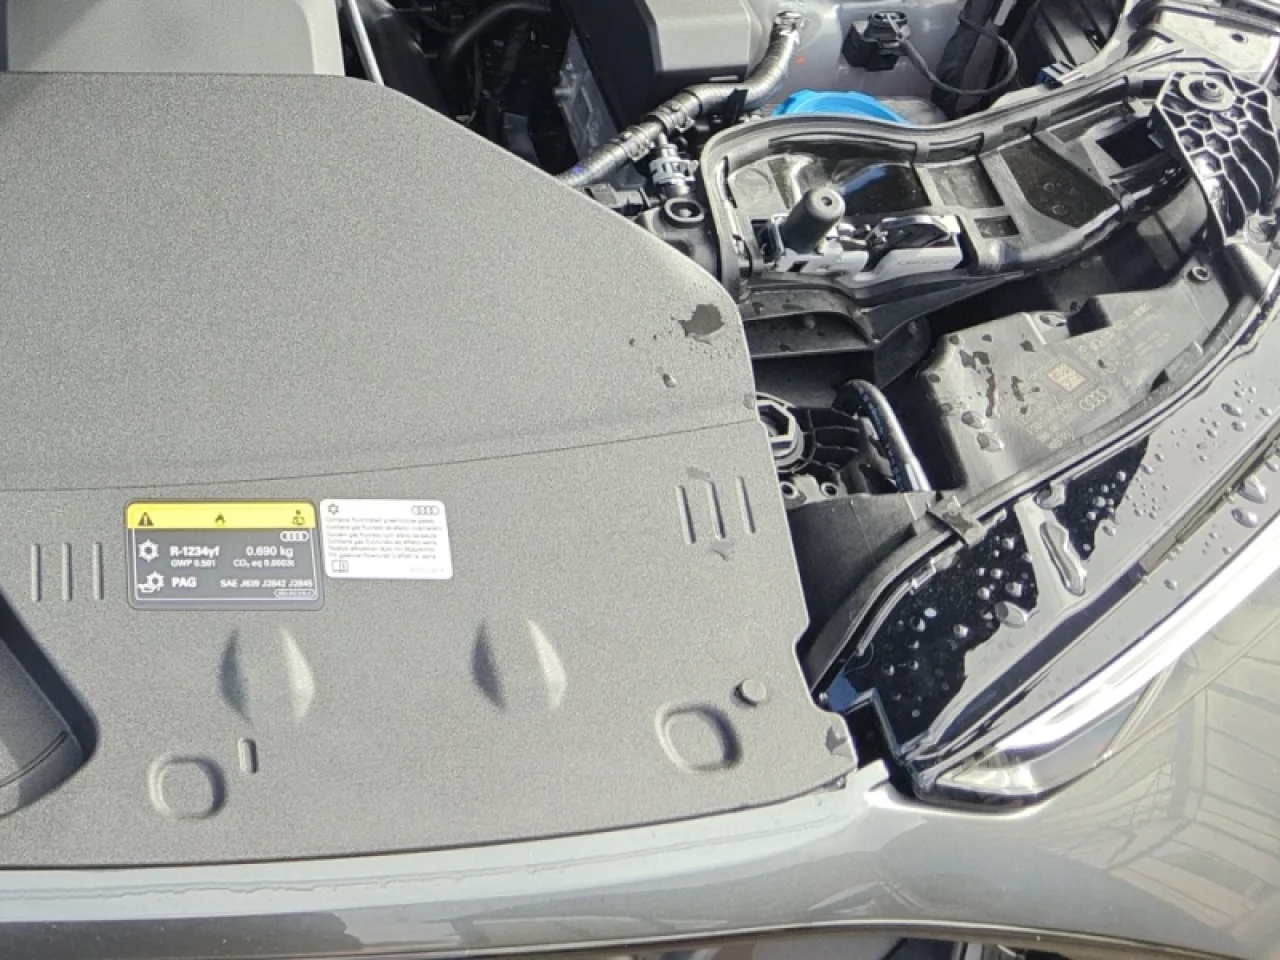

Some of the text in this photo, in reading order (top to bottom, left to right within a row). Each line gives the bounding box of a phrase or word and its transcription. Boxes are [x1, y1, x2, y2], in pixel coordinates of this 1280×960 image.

[169, 545, 294, 558] R-1234yf 0.690 kg
[170, 559, 192, 568] GWP
[171, 576, 197, 588] PAG
[220, 578, 238, 588] SAE
